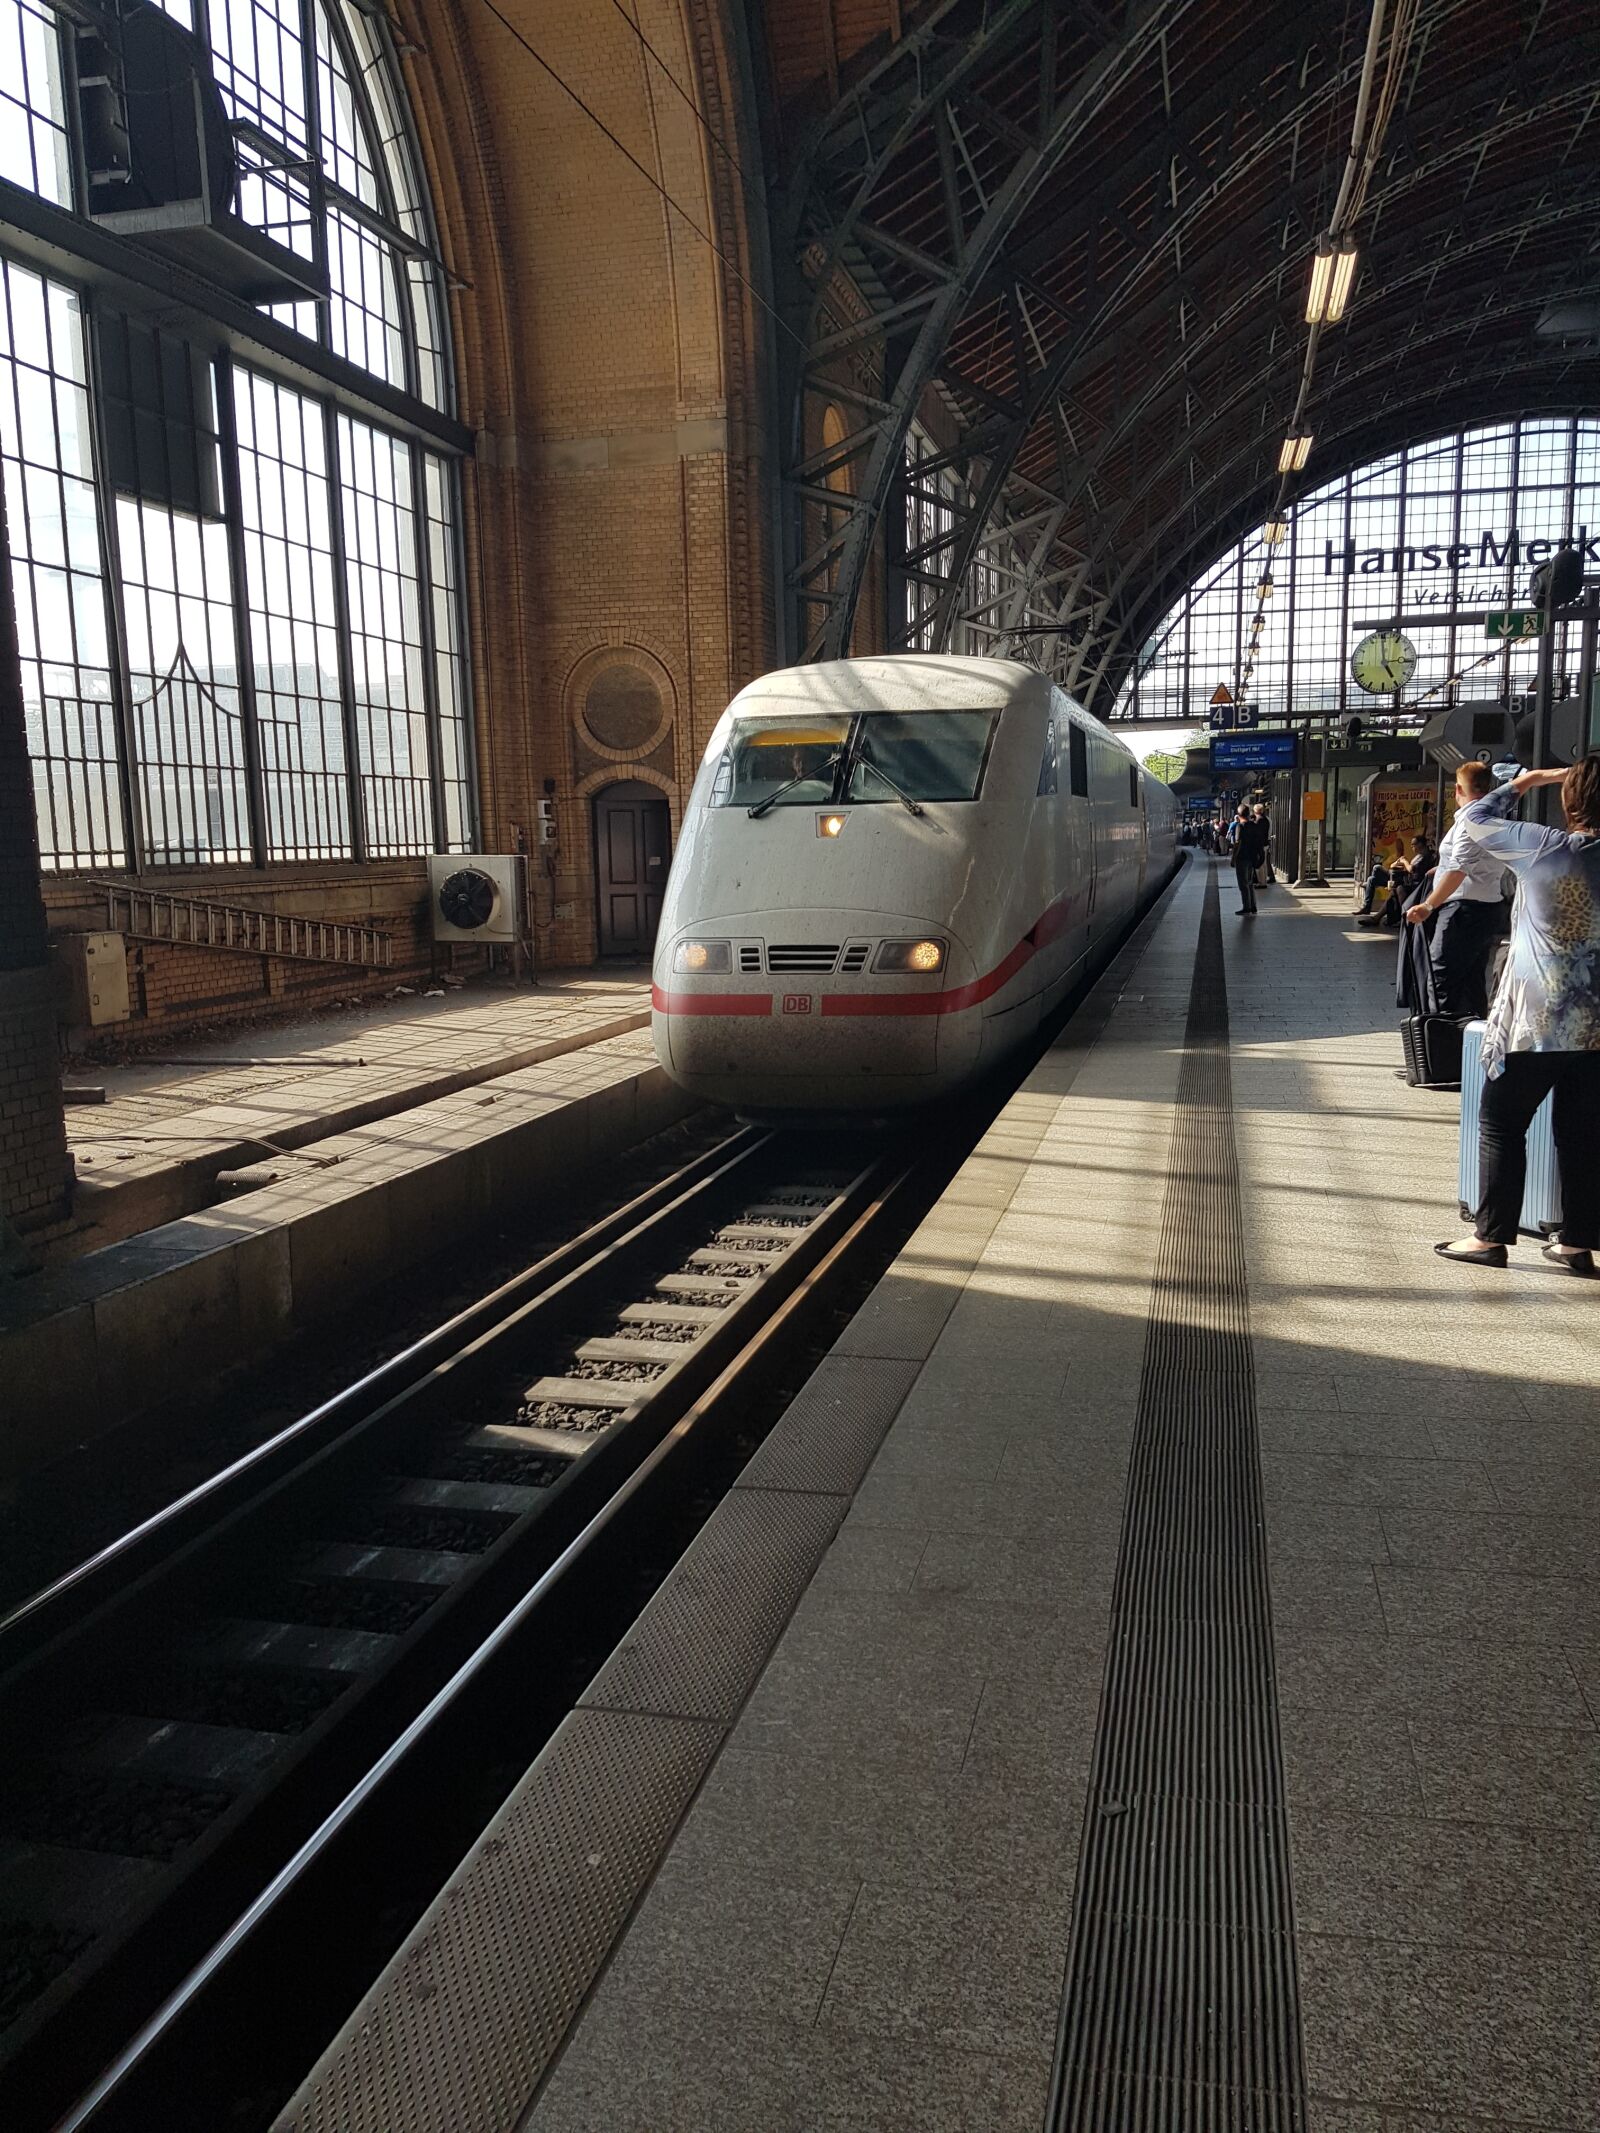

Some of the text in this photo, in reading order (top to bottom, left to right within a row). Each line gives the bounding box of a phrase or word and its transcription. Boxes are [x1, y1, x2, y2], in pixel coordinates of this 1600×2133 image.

[1508, 695, 1522, 714] B
[1212, 707, 1251, 725] 4 B
[1231, 791, 1238, 799] C
[786, 997, 809, 1011] DB
